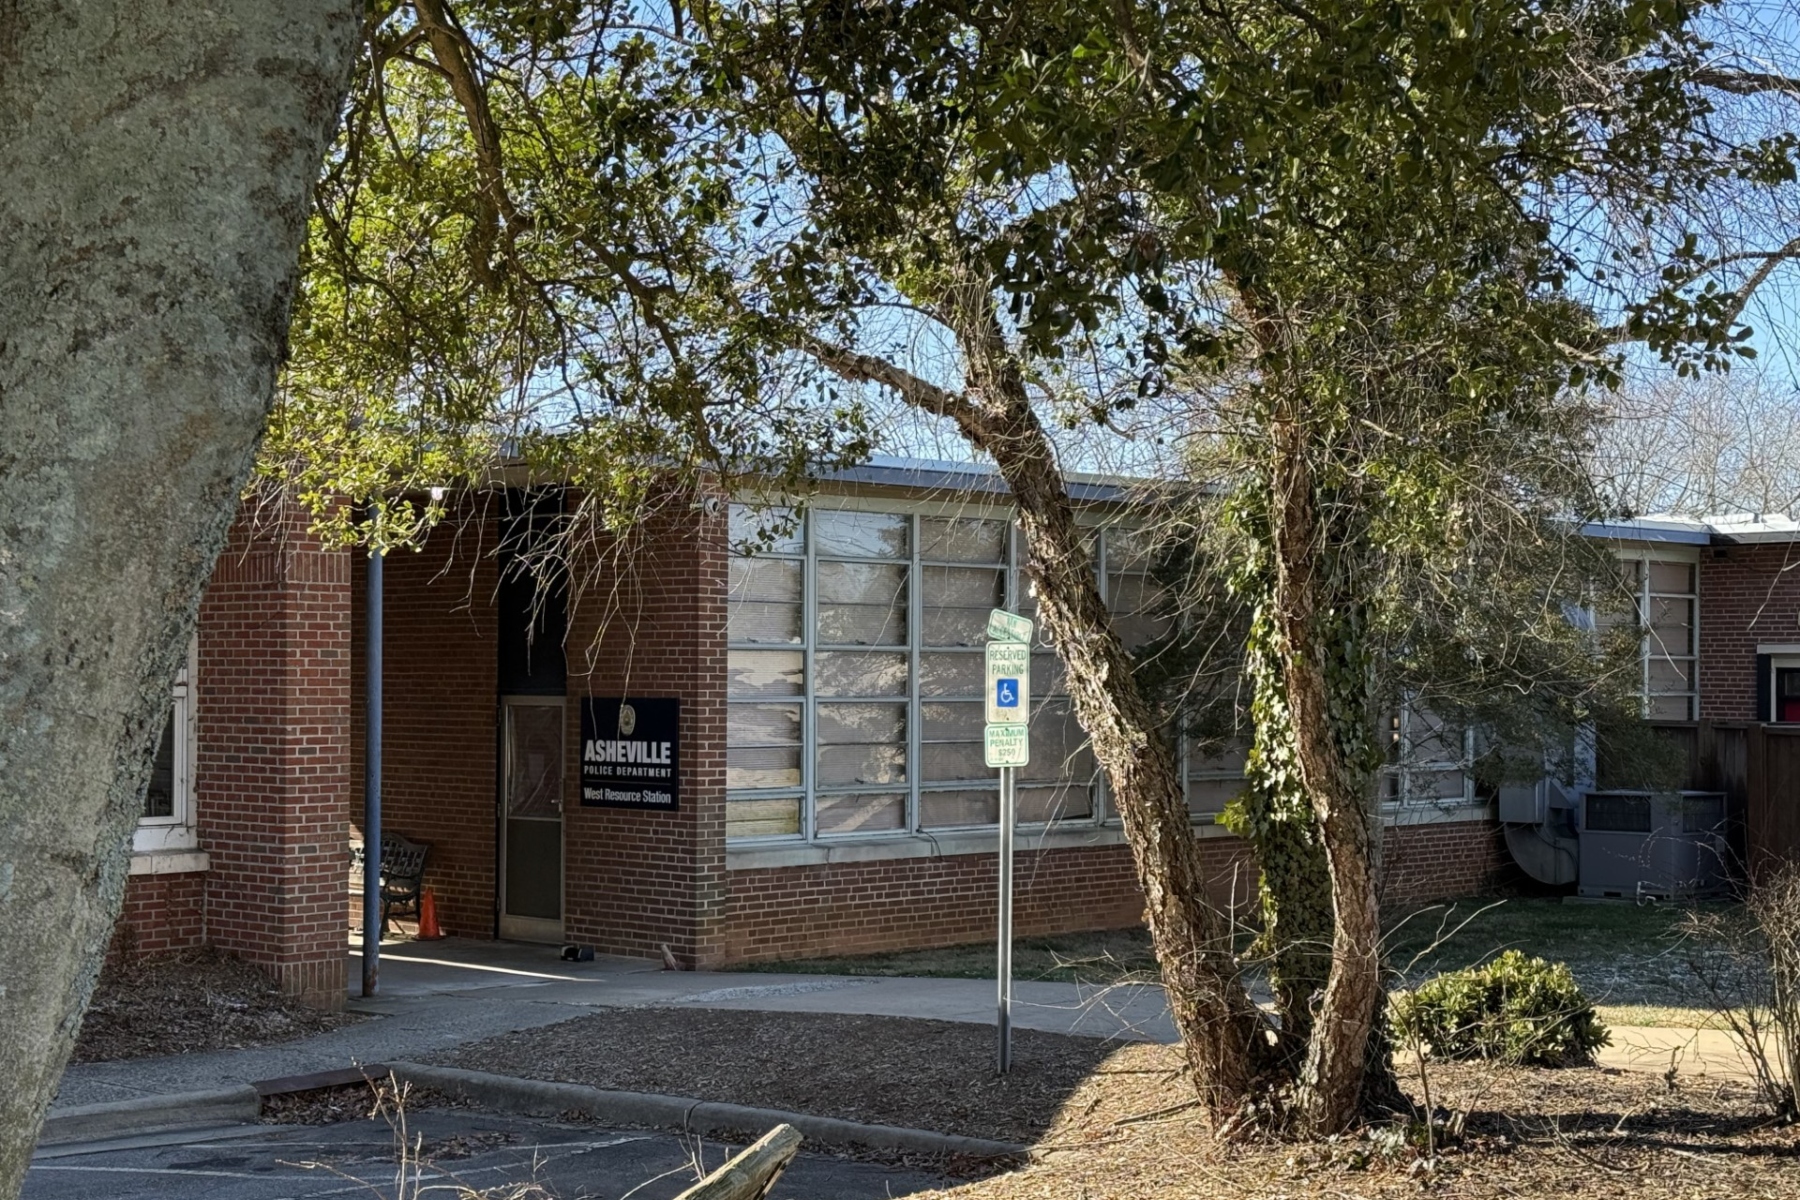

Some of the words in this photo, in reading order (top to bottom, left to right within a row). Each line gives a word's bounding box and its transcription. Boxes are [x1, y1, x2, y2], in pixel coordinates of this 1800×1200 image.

[989, 649, 1026, 661] RESERVED
[992, 664, 1024, 675] PARKING
[989, 728, 1024, 738] MAXIMUM
[990, 738, 1024, 747] PENALTY
[584, 740, 671, 764] ASHEVILLE
[998, 748, 1016, 756] $250
[584, 765, 613, 775] POLICE
[616, 766, 672, 778] DEPARTMENT
[584, 787, 604, 800] West
[604, 788, 641, 802] Resource
[642, 790, 671, 804] Station
